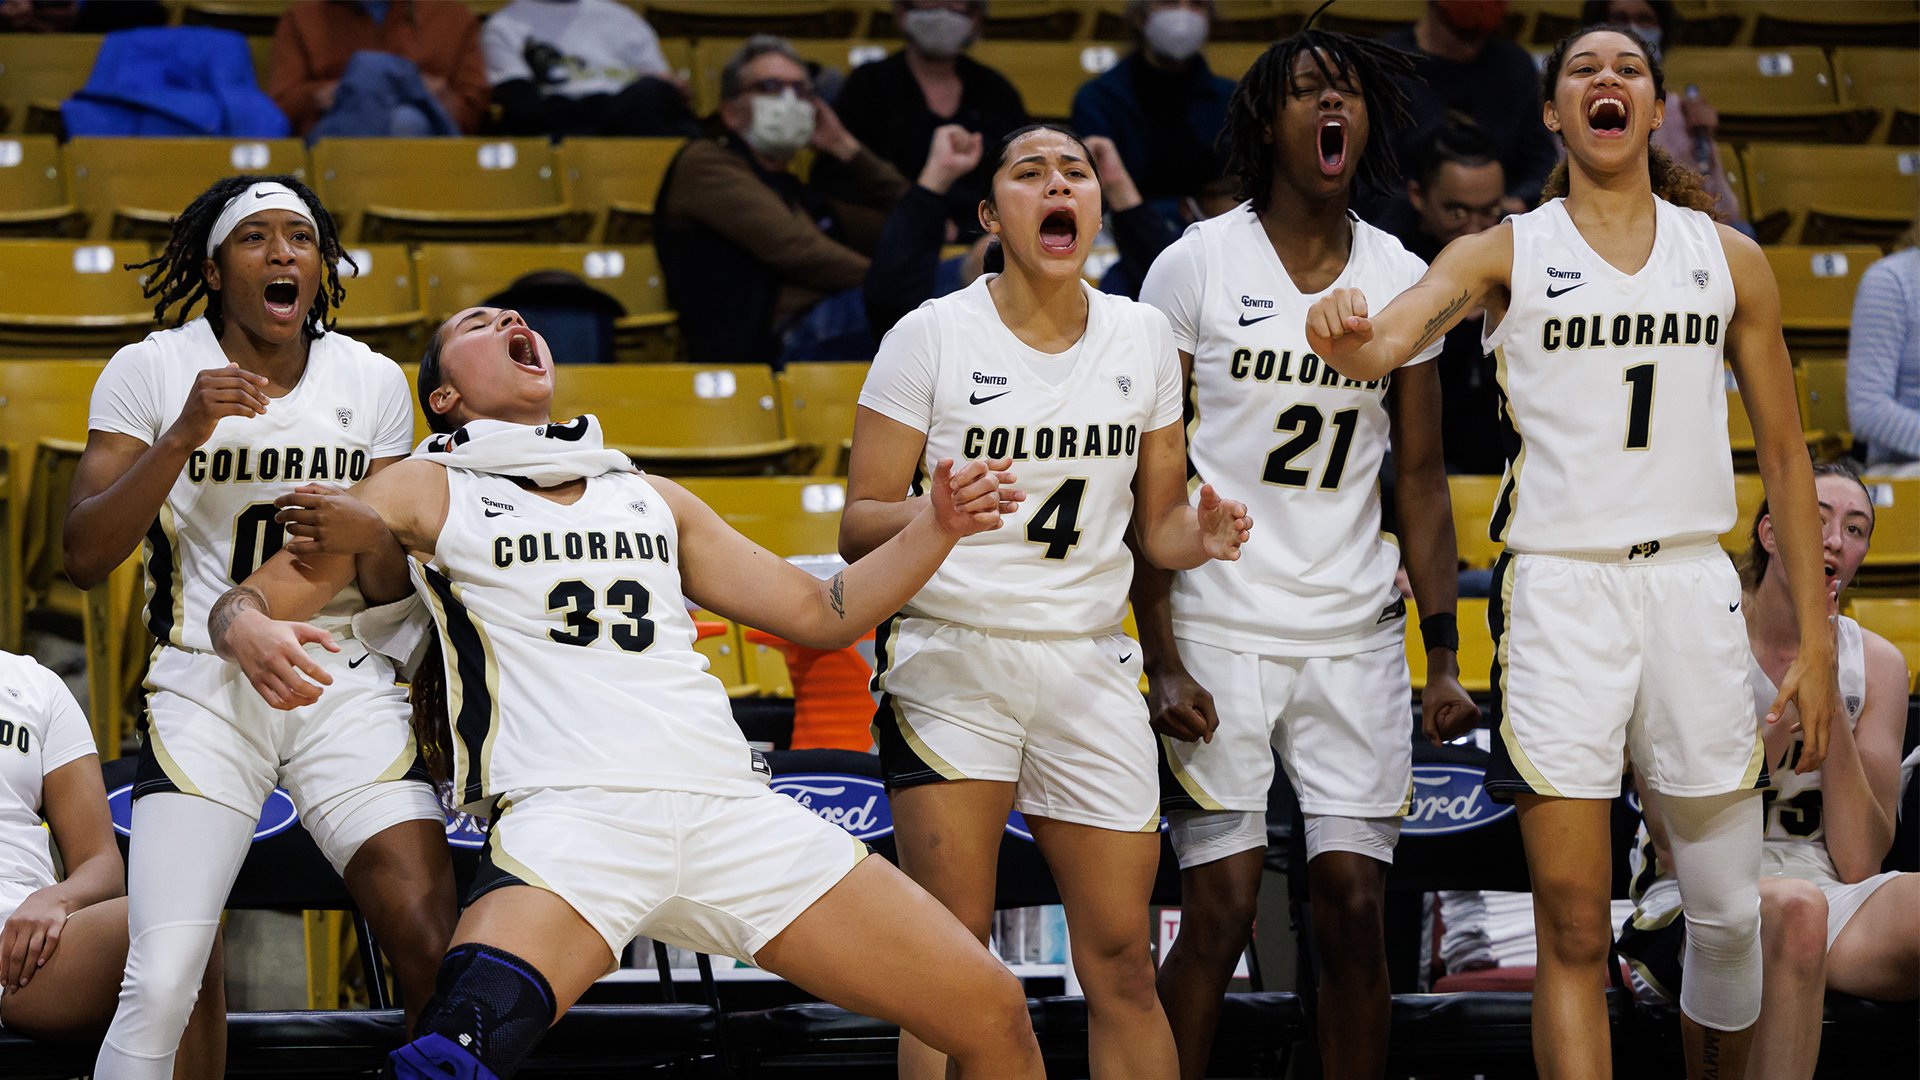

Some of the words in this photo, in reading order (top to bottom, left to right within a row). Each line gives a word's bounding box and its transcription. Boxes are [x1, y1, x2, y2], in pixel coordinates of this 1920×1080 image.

[1541, 312, 1719, 353] COLORADO
[1229, 346, 1391, 392] COLOR
[1622, 361, 1658, 451] 1
[187, 446, 367, 484] COLORADO
[962, 423, 1137, 461] COLORADO
[1260, 402, 1360, 493] 21
[1024, 476, 1089, 560] 4
[492, 530, 670, 570] COLORADO
[545, 577, 656, 654] 33
[772, 783, 878, 831] Frd
